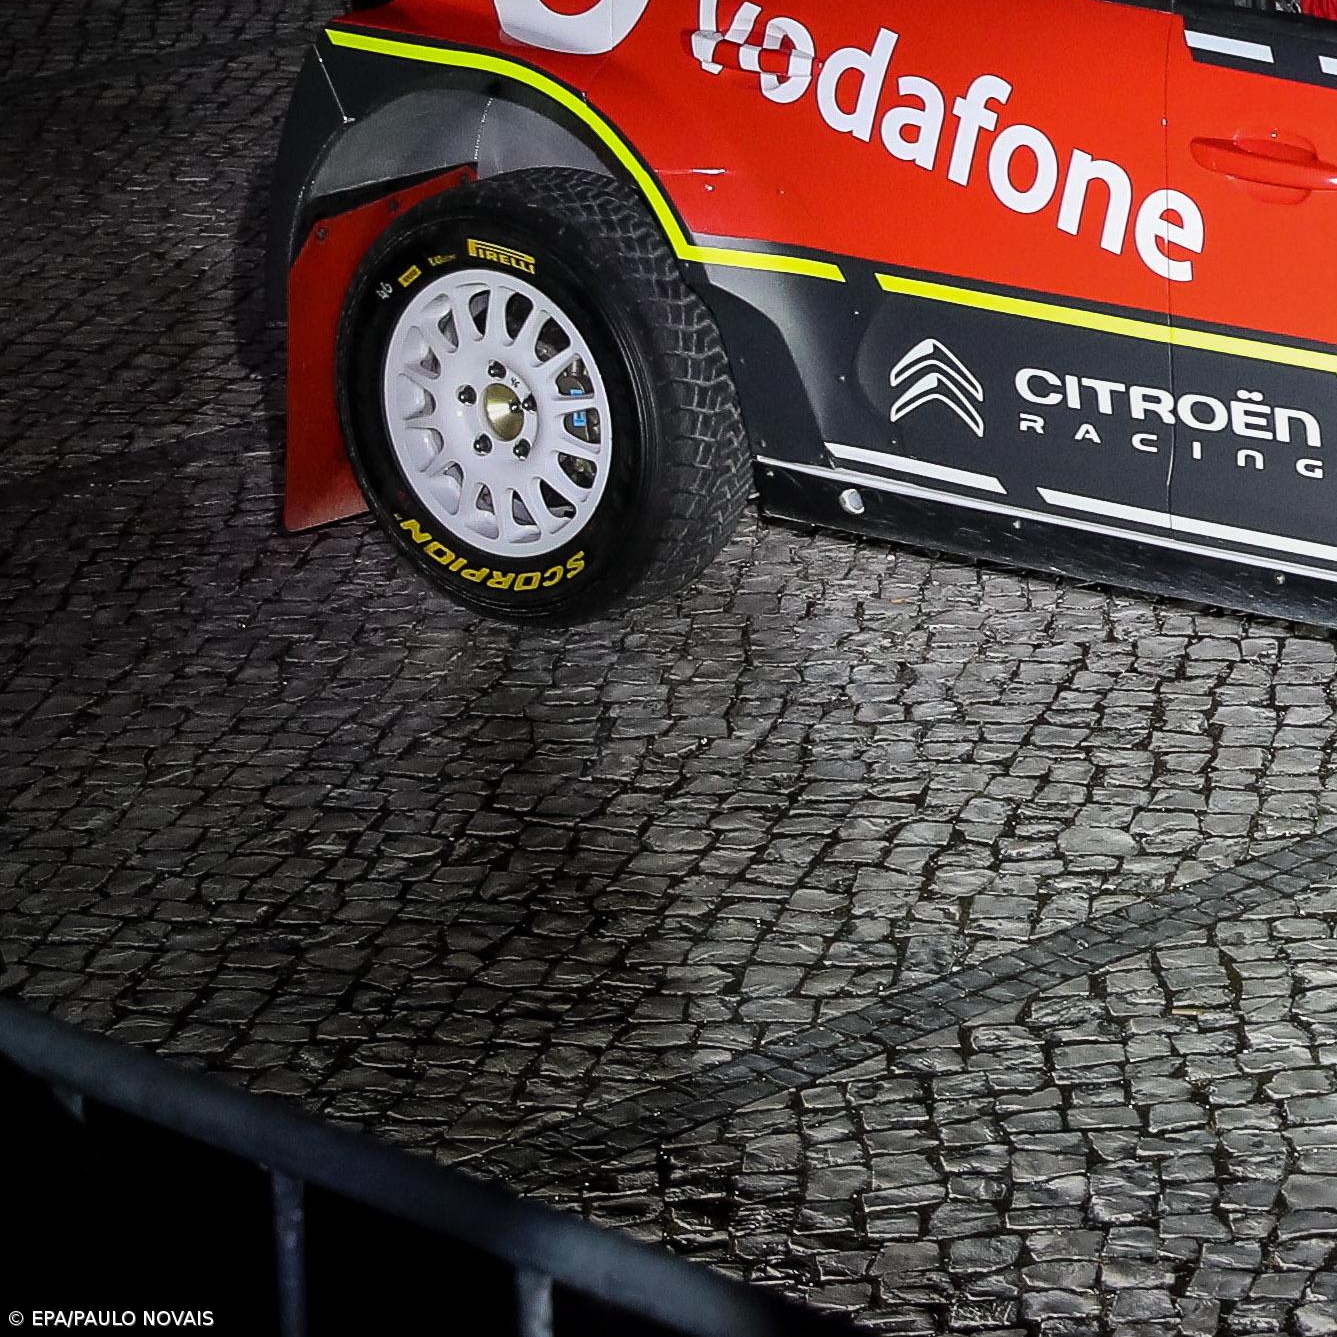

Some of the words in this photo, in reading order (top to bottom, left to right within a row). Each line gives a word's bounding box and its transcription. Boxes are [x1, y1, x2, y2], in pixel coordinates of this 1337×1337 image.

[466, 238, 536, 275] PIRELLI
[1014, 367, 1323, 448] CITROËN
[1018, 413, 1324, 479] RACING
[400, 517, 586, 592] SCORPION
